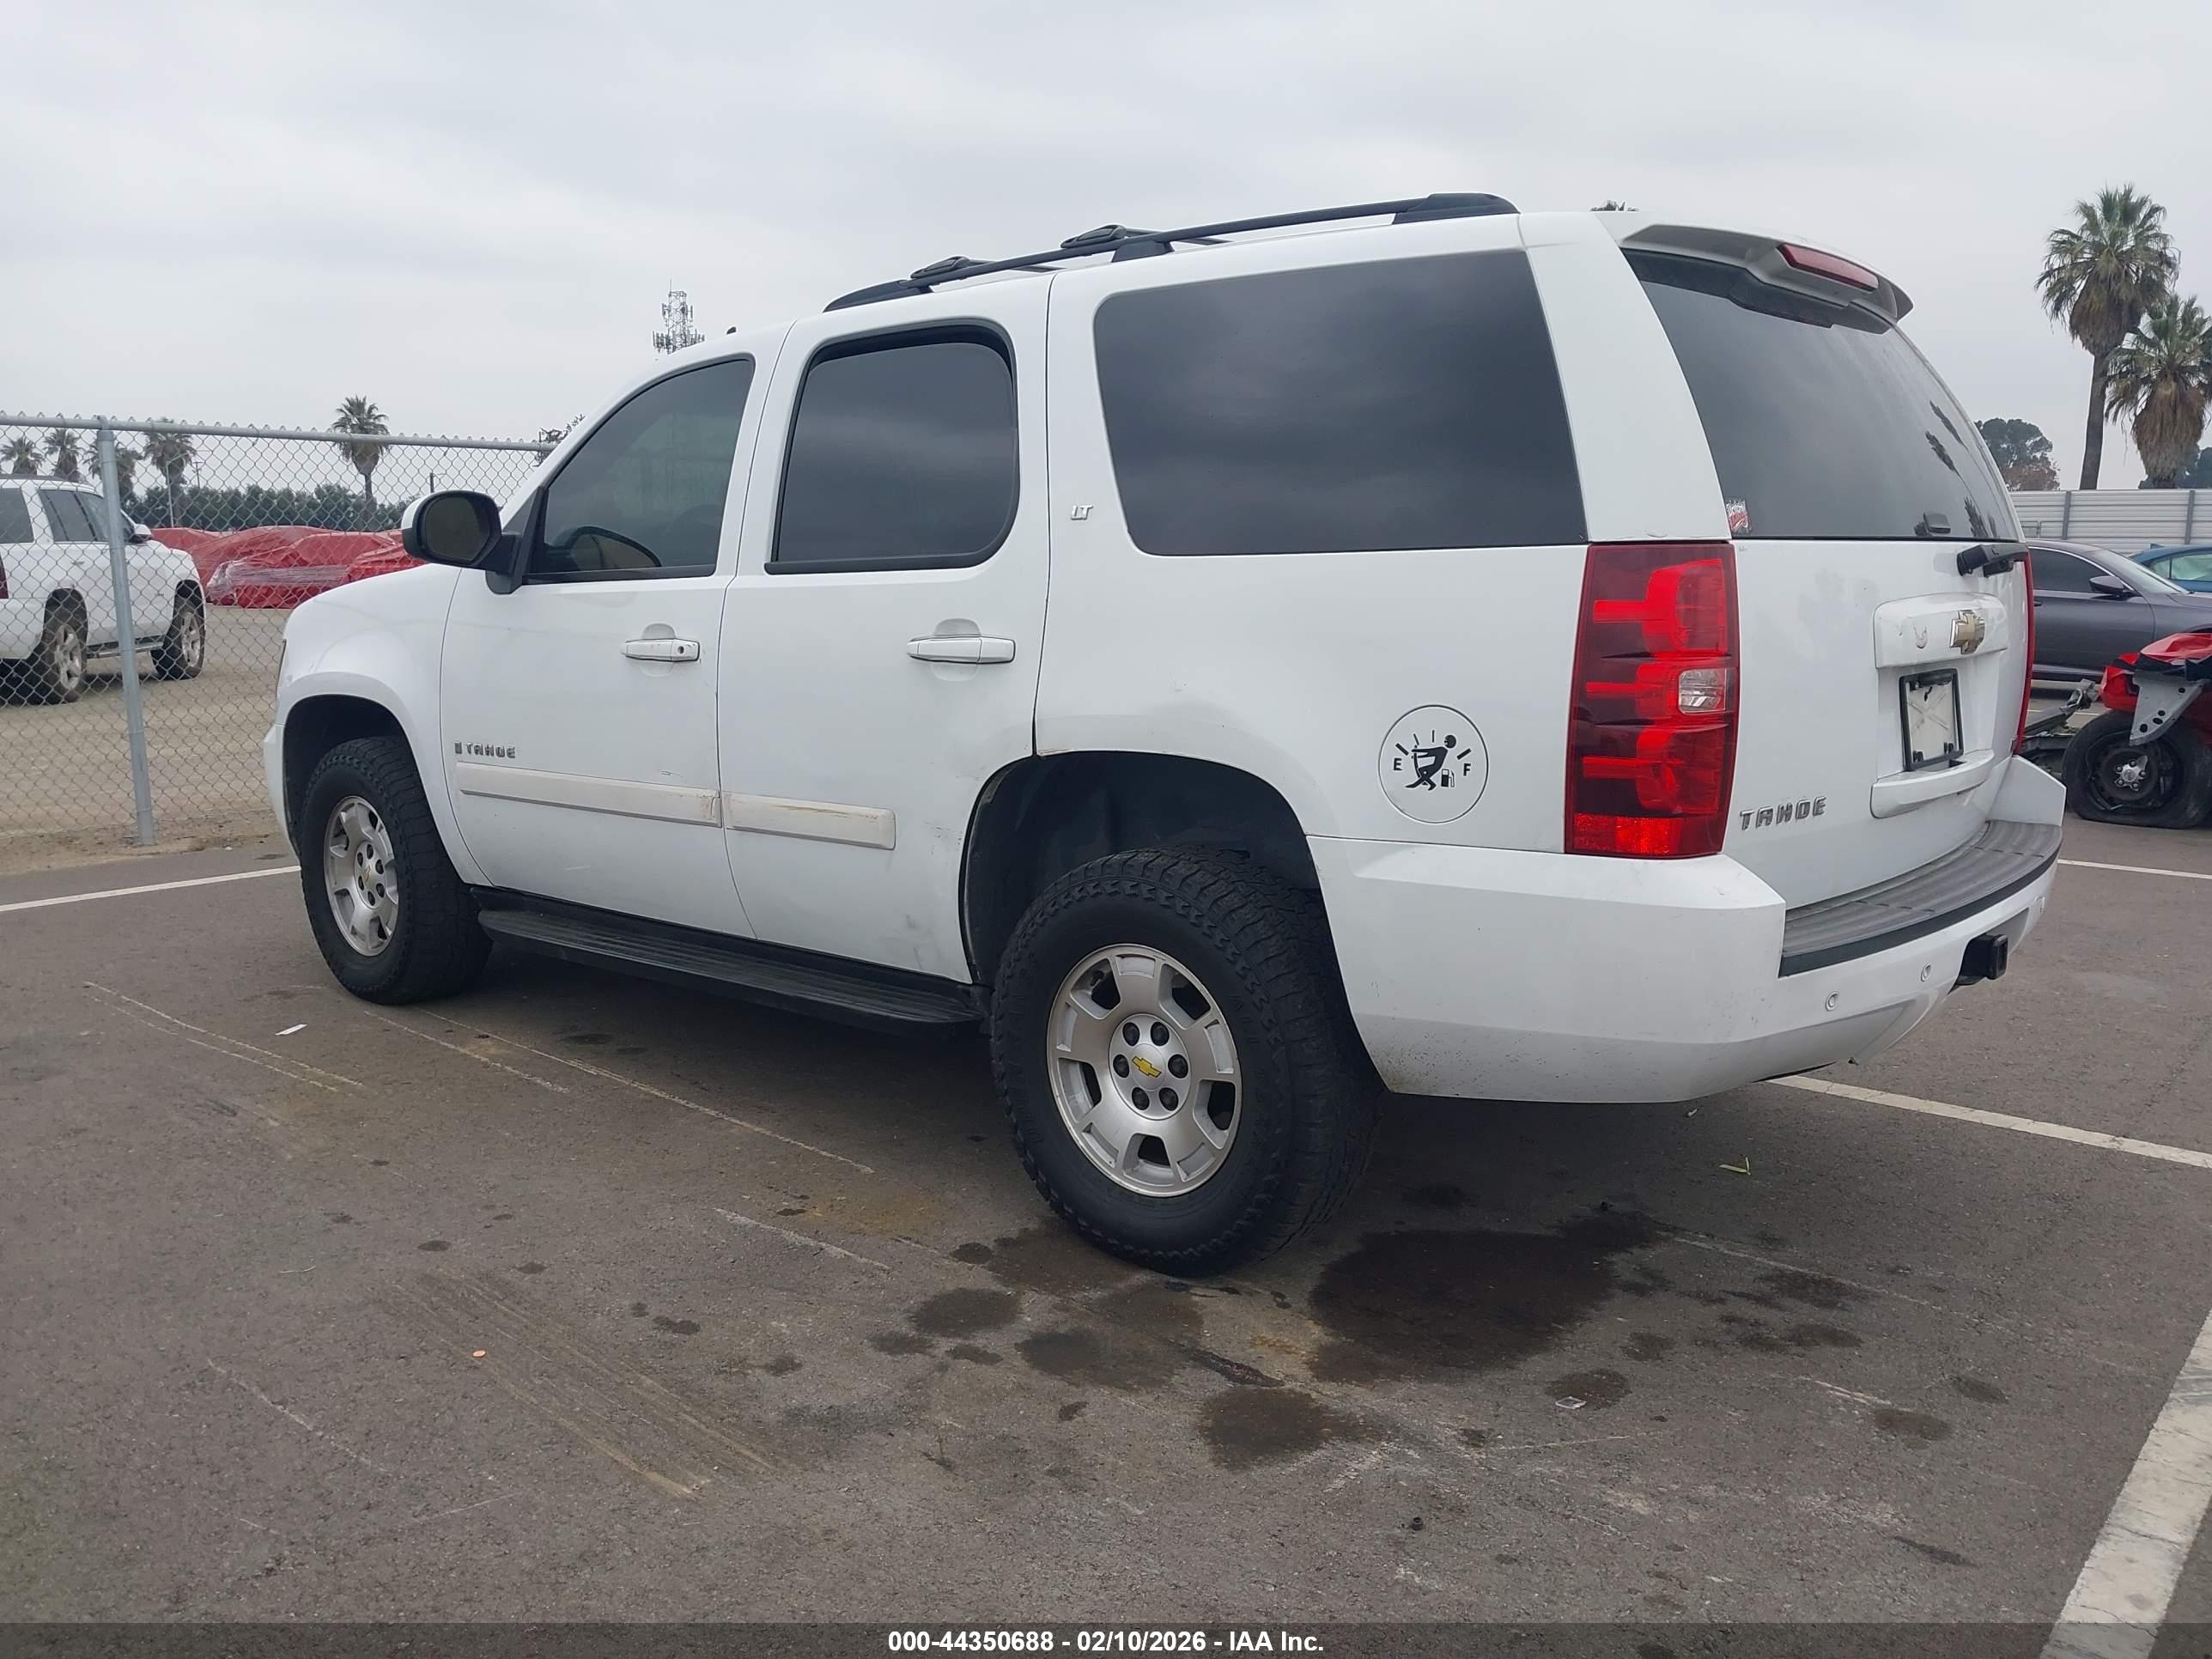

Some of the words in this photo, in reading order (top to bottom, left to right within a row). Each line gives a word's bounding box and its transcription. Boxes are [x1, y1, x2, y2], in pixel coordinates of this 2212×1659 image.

[1071, 505, 1094, 521] LT
[466, 742, 516, 758] TAHOE
[1393, 757, 1403, 771] E
[1463, 763, 1472, 776] F
[1739, 795, 1827, 830] TAHOE
